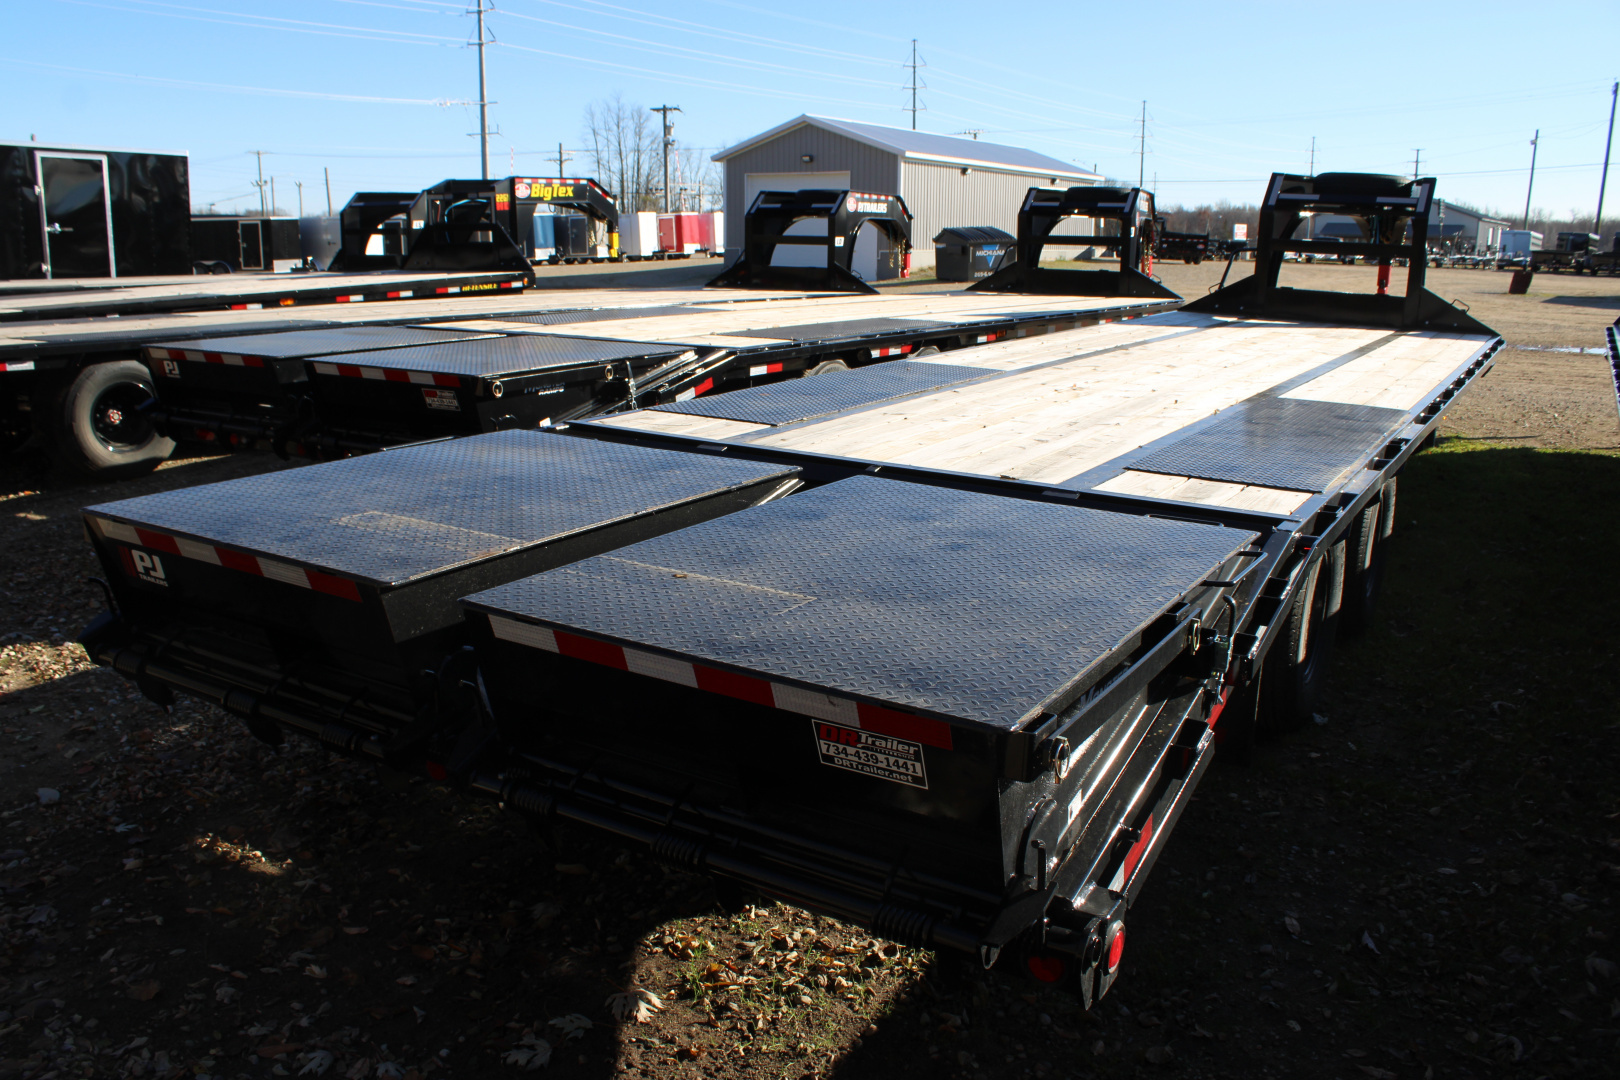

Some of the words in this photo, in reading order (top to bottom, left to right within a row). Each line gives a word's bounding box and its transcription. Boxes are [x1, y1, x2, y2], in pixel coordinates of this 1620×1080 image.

[530, 183, 574, 201] BigTex
[163, 360, 180, 375] PJ
[131, 549, 166, 580] PJ
[139, 573, 169, 587] TRAILERS
[819, 723, 859, 748] DR
[859, 732, 919, 756] Trailer
[823, 743, 920, 775] 734-439-1441
[833, 757, 914, 783] DRTrailer.net
